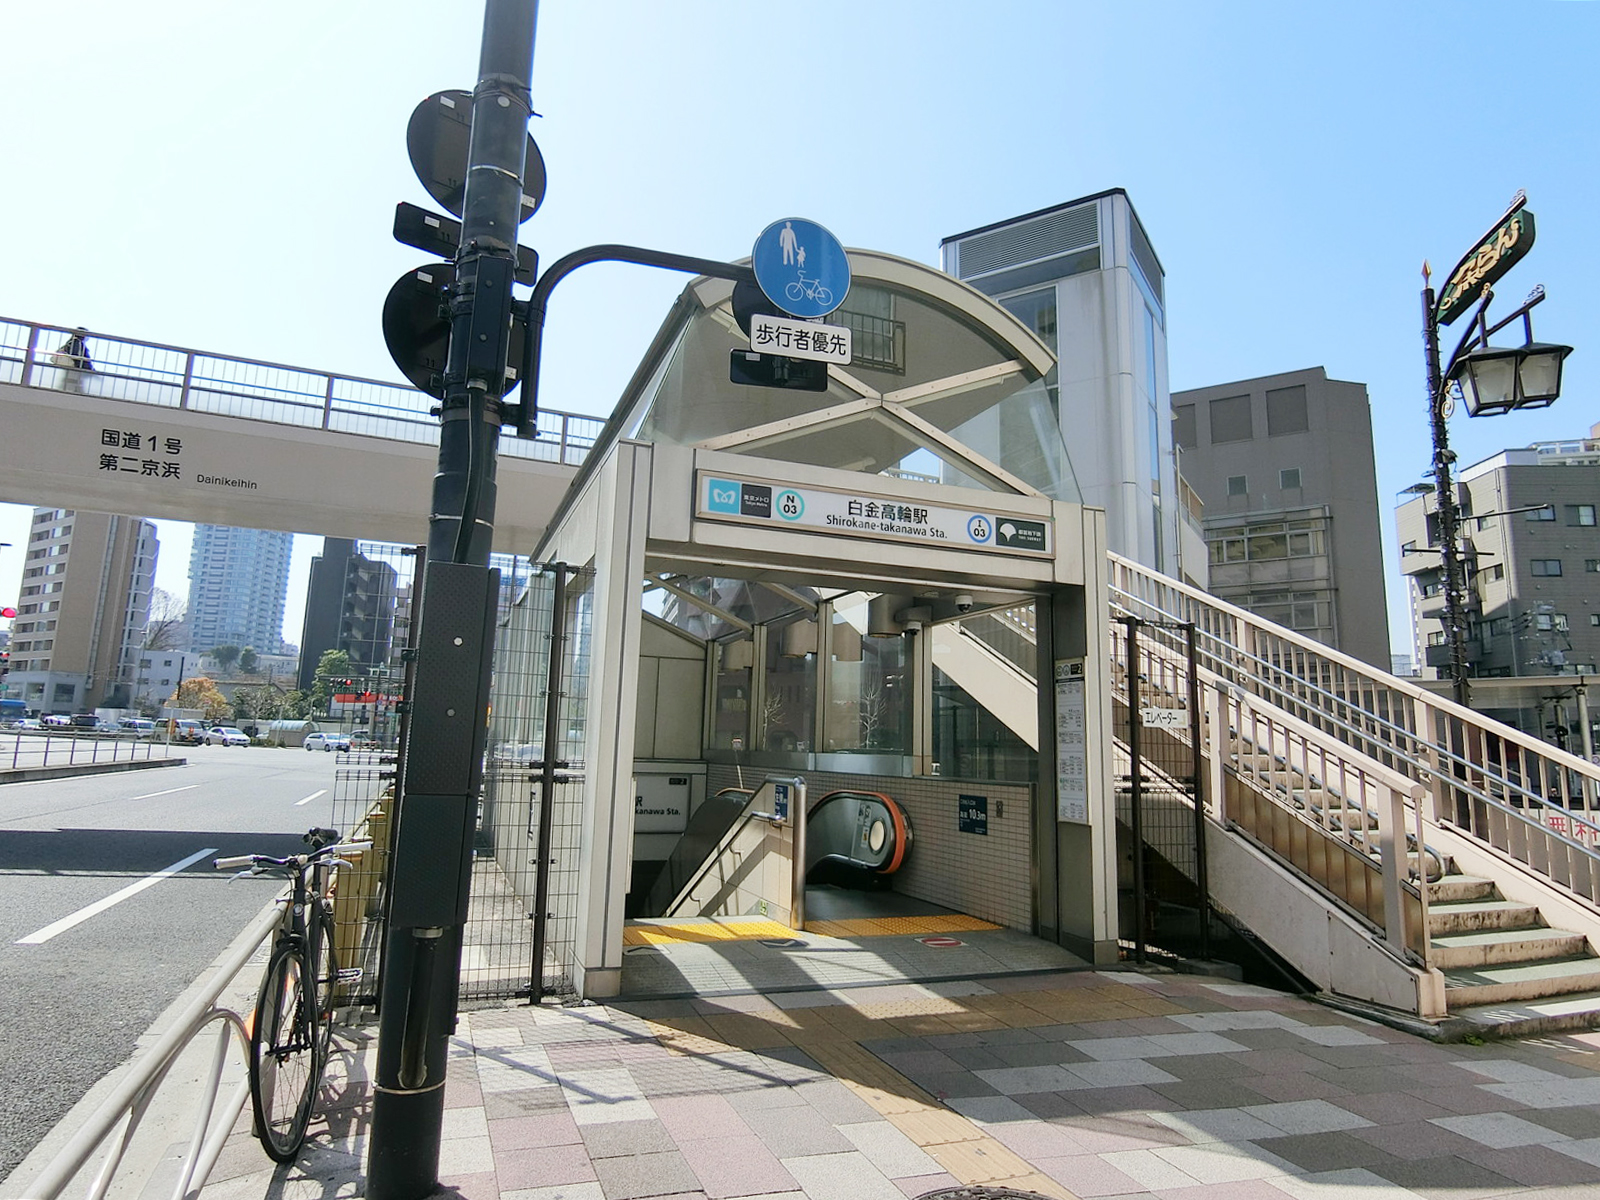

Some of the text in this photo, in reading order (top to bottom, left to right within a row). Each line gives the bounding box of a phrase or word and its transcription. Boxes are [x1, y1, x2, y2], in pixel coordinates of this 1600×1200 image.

[755, 323, 847, 356] 歩行者優先
[101, 428, 183, 455] 国道1号
[99, 453, 181, 480] 第二京浜
[196, 474, 258, 490] Dainikeihin
[786, 494, 795, 504] N
[783, 504, 797, 515] 03
[848, 499, 928, 525] 白金高輪駅
[826, 514, 948, 539] Shirokane-takanawa Sta.
[977, 520, 982, 528] I
[973, 528, 986, 538] 03
[1077, 664, 1082, 674] 2
[1145, 711, 1178, 724] エレベーター
[666, 807, 681, 816] Sta.
